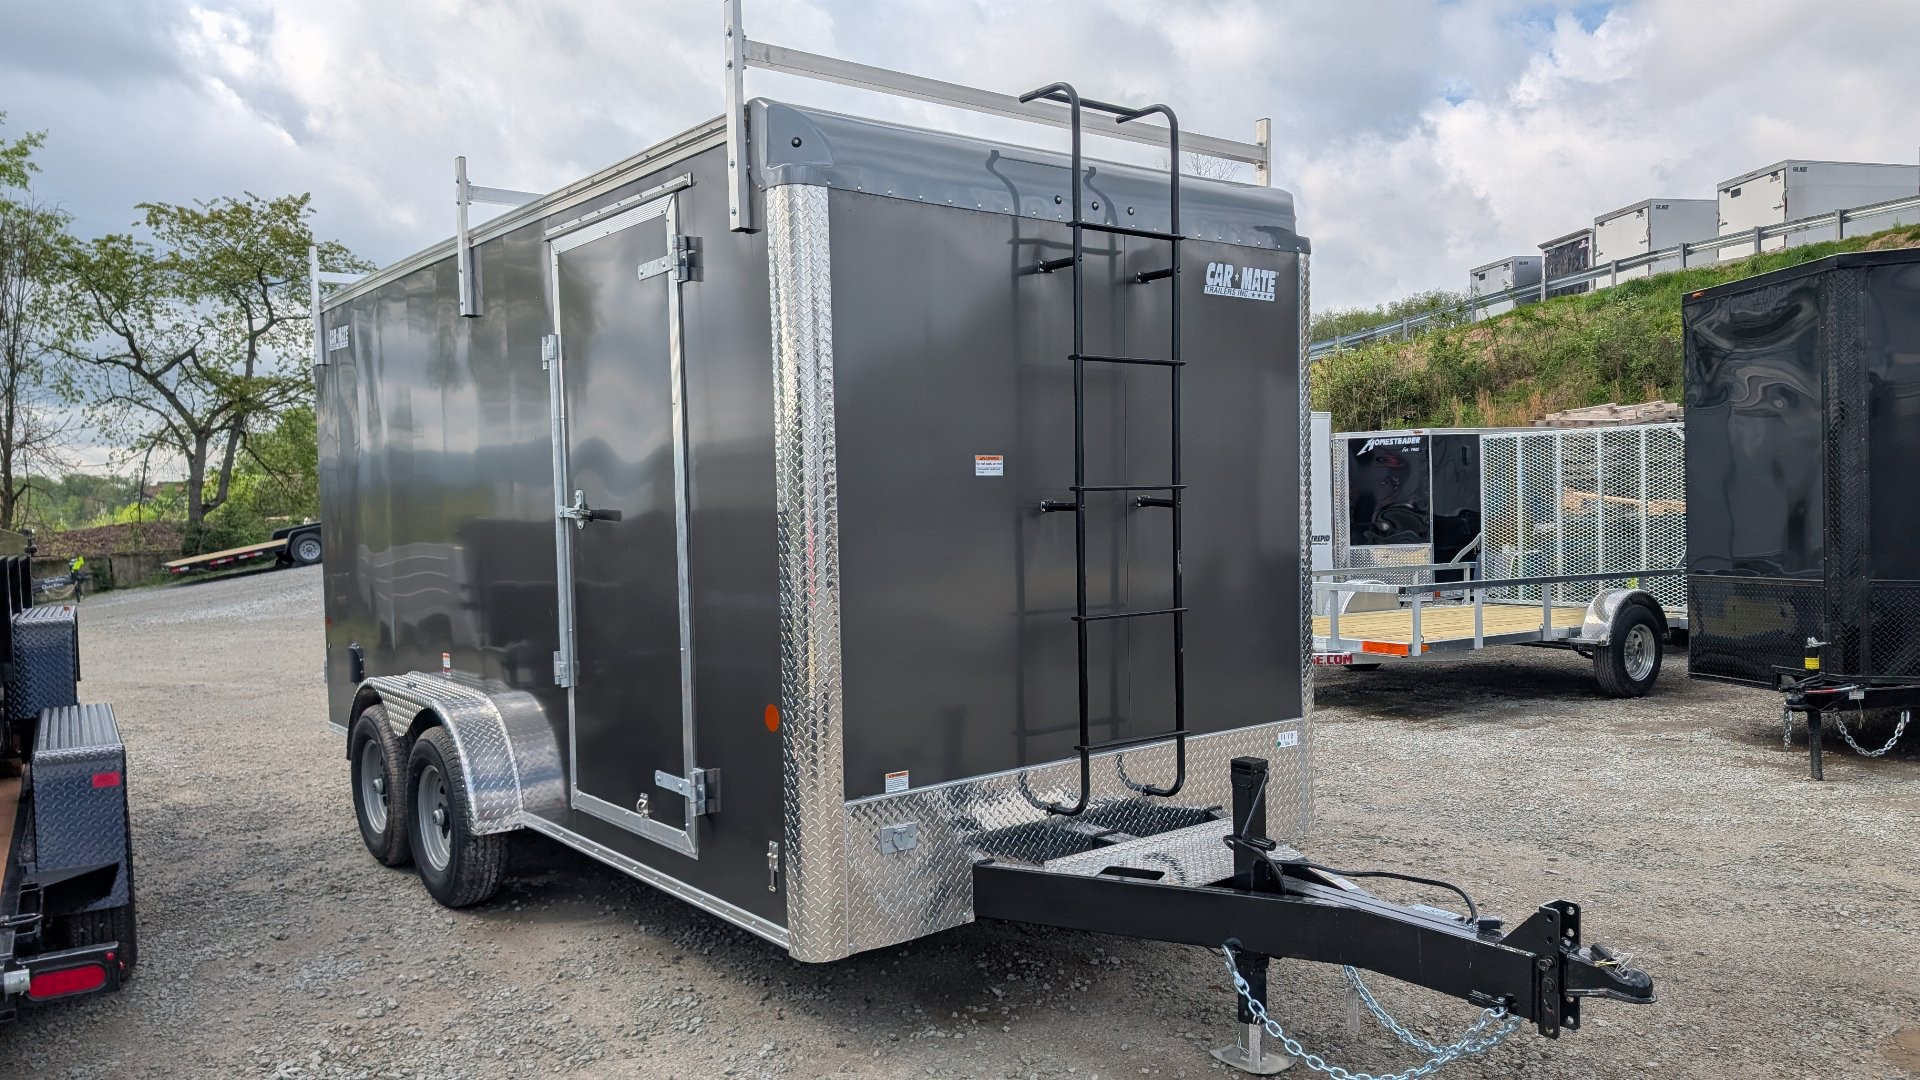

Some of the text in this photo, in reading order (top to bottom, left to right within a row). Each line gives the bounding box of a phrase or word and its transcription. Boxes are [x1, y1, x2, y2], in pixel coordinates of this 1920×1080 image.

[1206, 262, 1276, 293] CAR MATE
[1206, 286, 1236, 296] TRAILERS
[1357, 436, 1421, 456] HOMESTEADER
